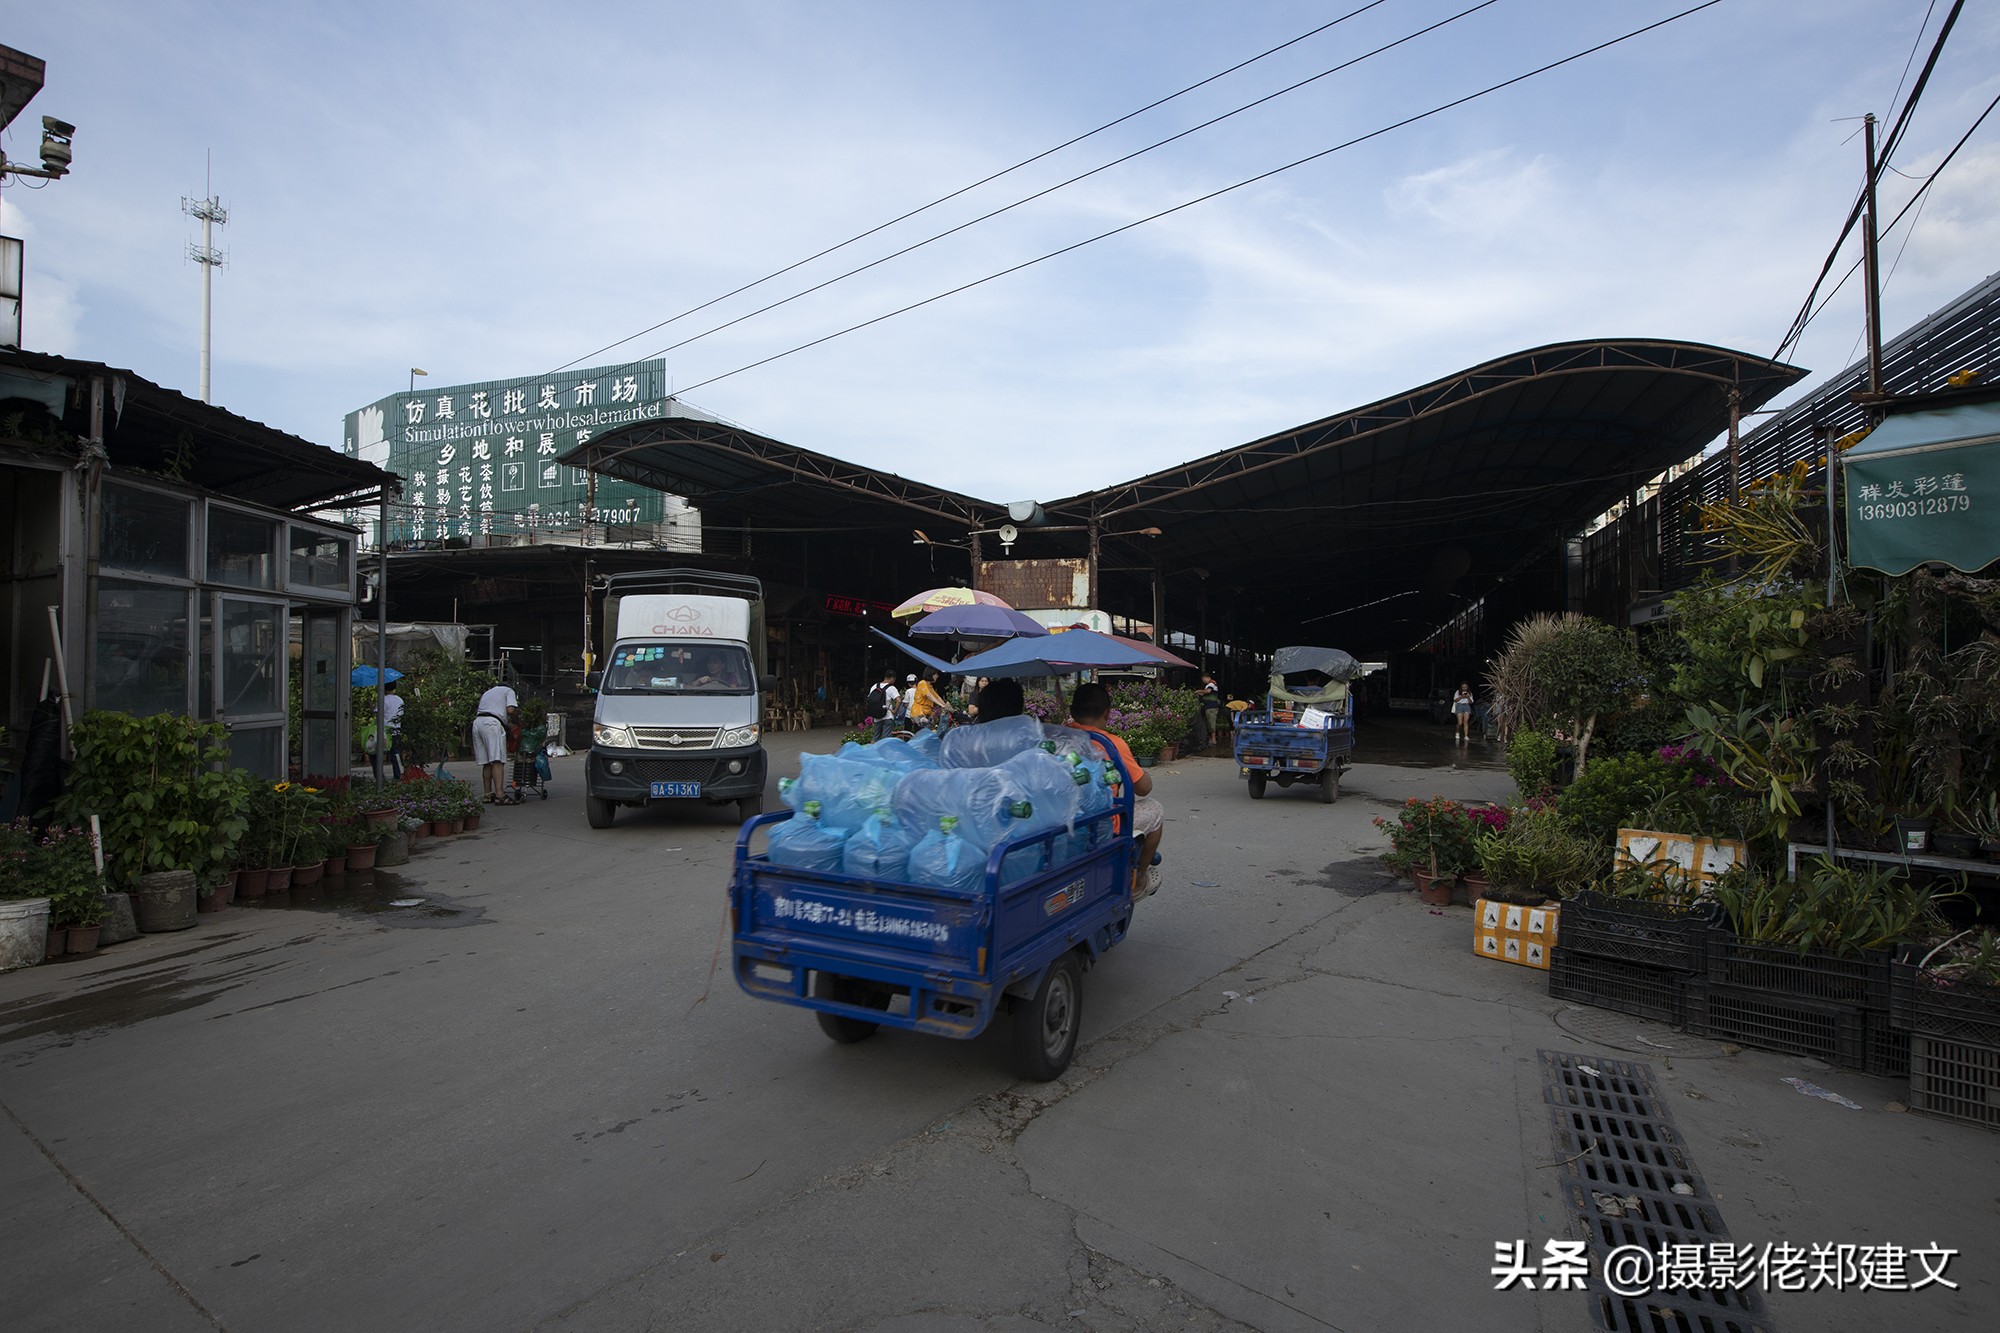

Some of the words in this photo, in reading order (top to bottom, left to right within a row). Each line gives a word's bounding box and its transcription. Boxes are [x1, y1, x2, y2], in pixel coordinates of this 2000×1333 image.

[405, 376, 638, 424] 仿真花批发市场
[1858, 495, 1970, 521] 13690312879
[651, 624, 713, 636] CHANA
